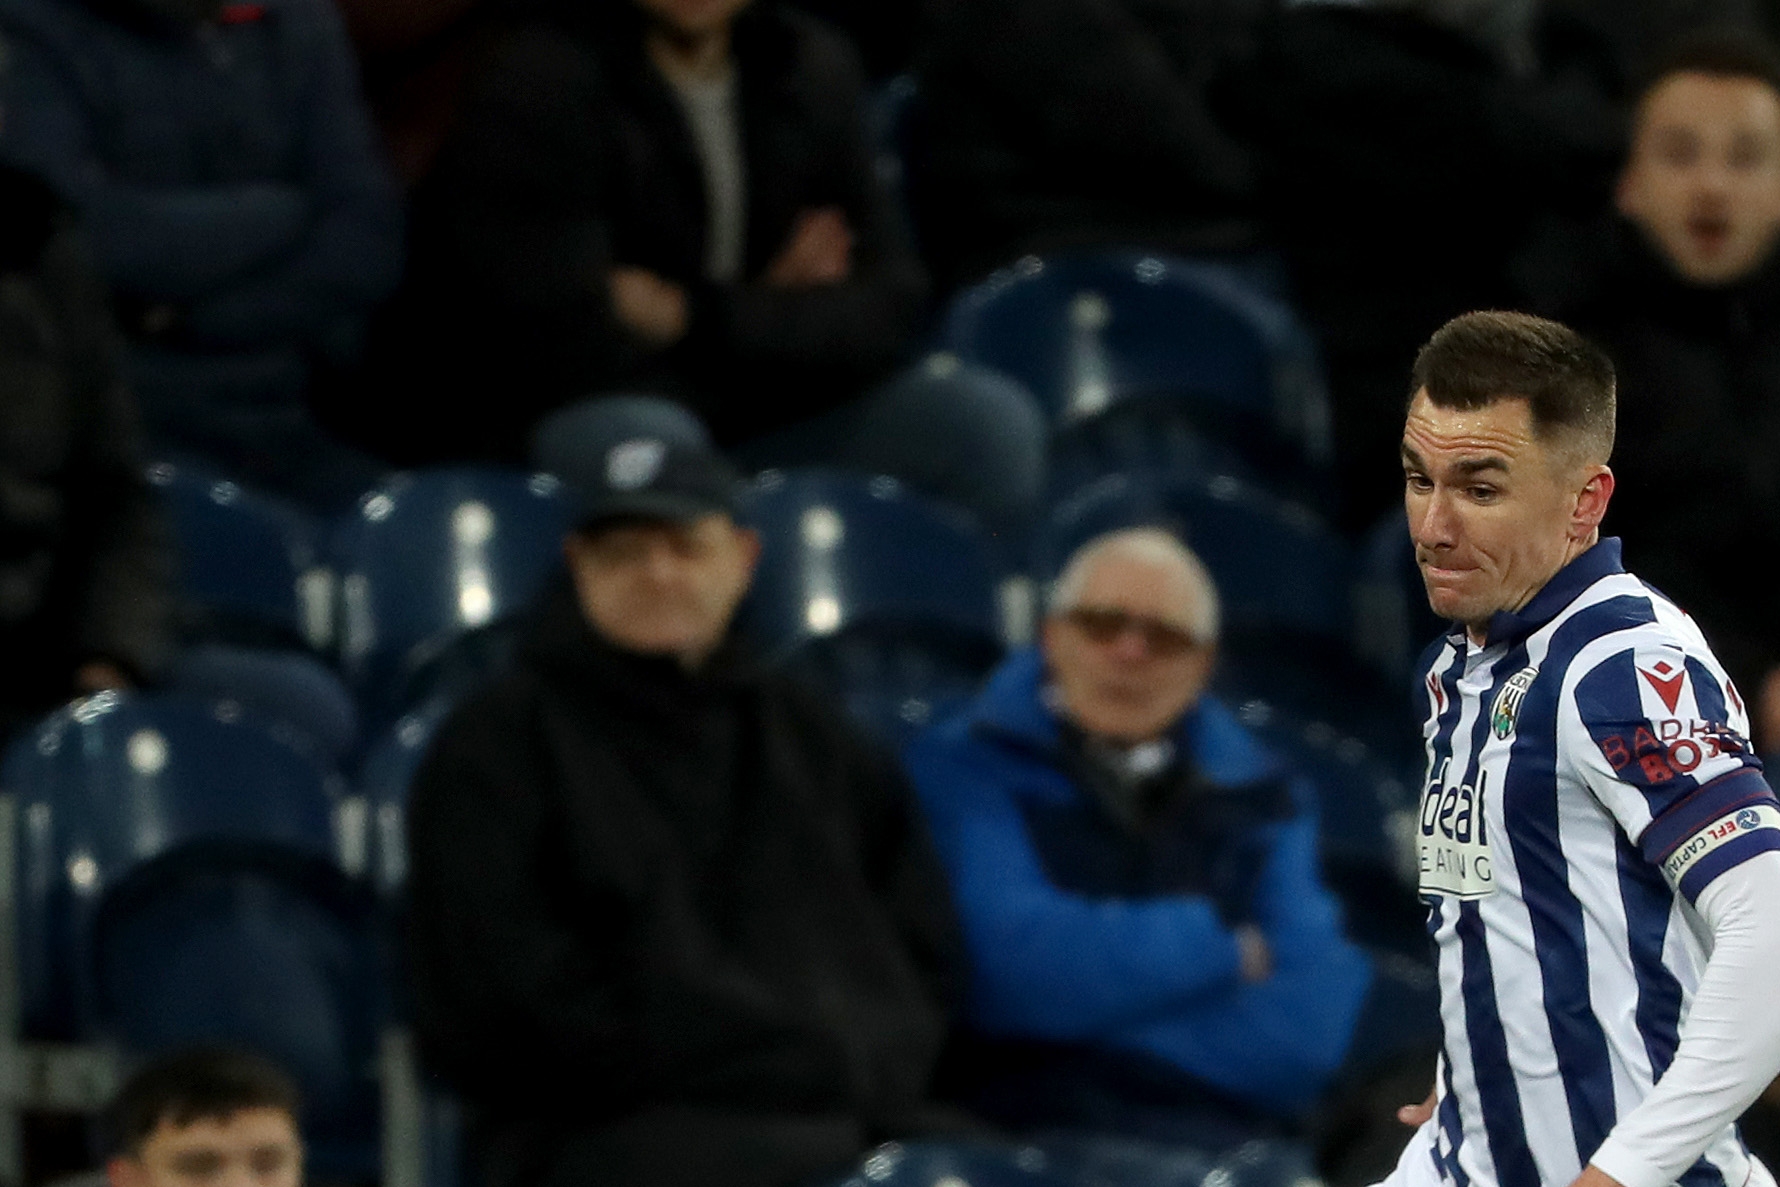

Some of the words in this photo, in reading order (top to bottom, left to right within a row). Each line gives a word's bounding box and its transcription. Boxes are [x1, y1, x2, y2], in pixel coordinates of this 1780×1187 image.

[1422, 760, 1488, 846] deal
[1707, 820, 1737, 841] EFL
[1420, 845, 1493, 882] EATNG
